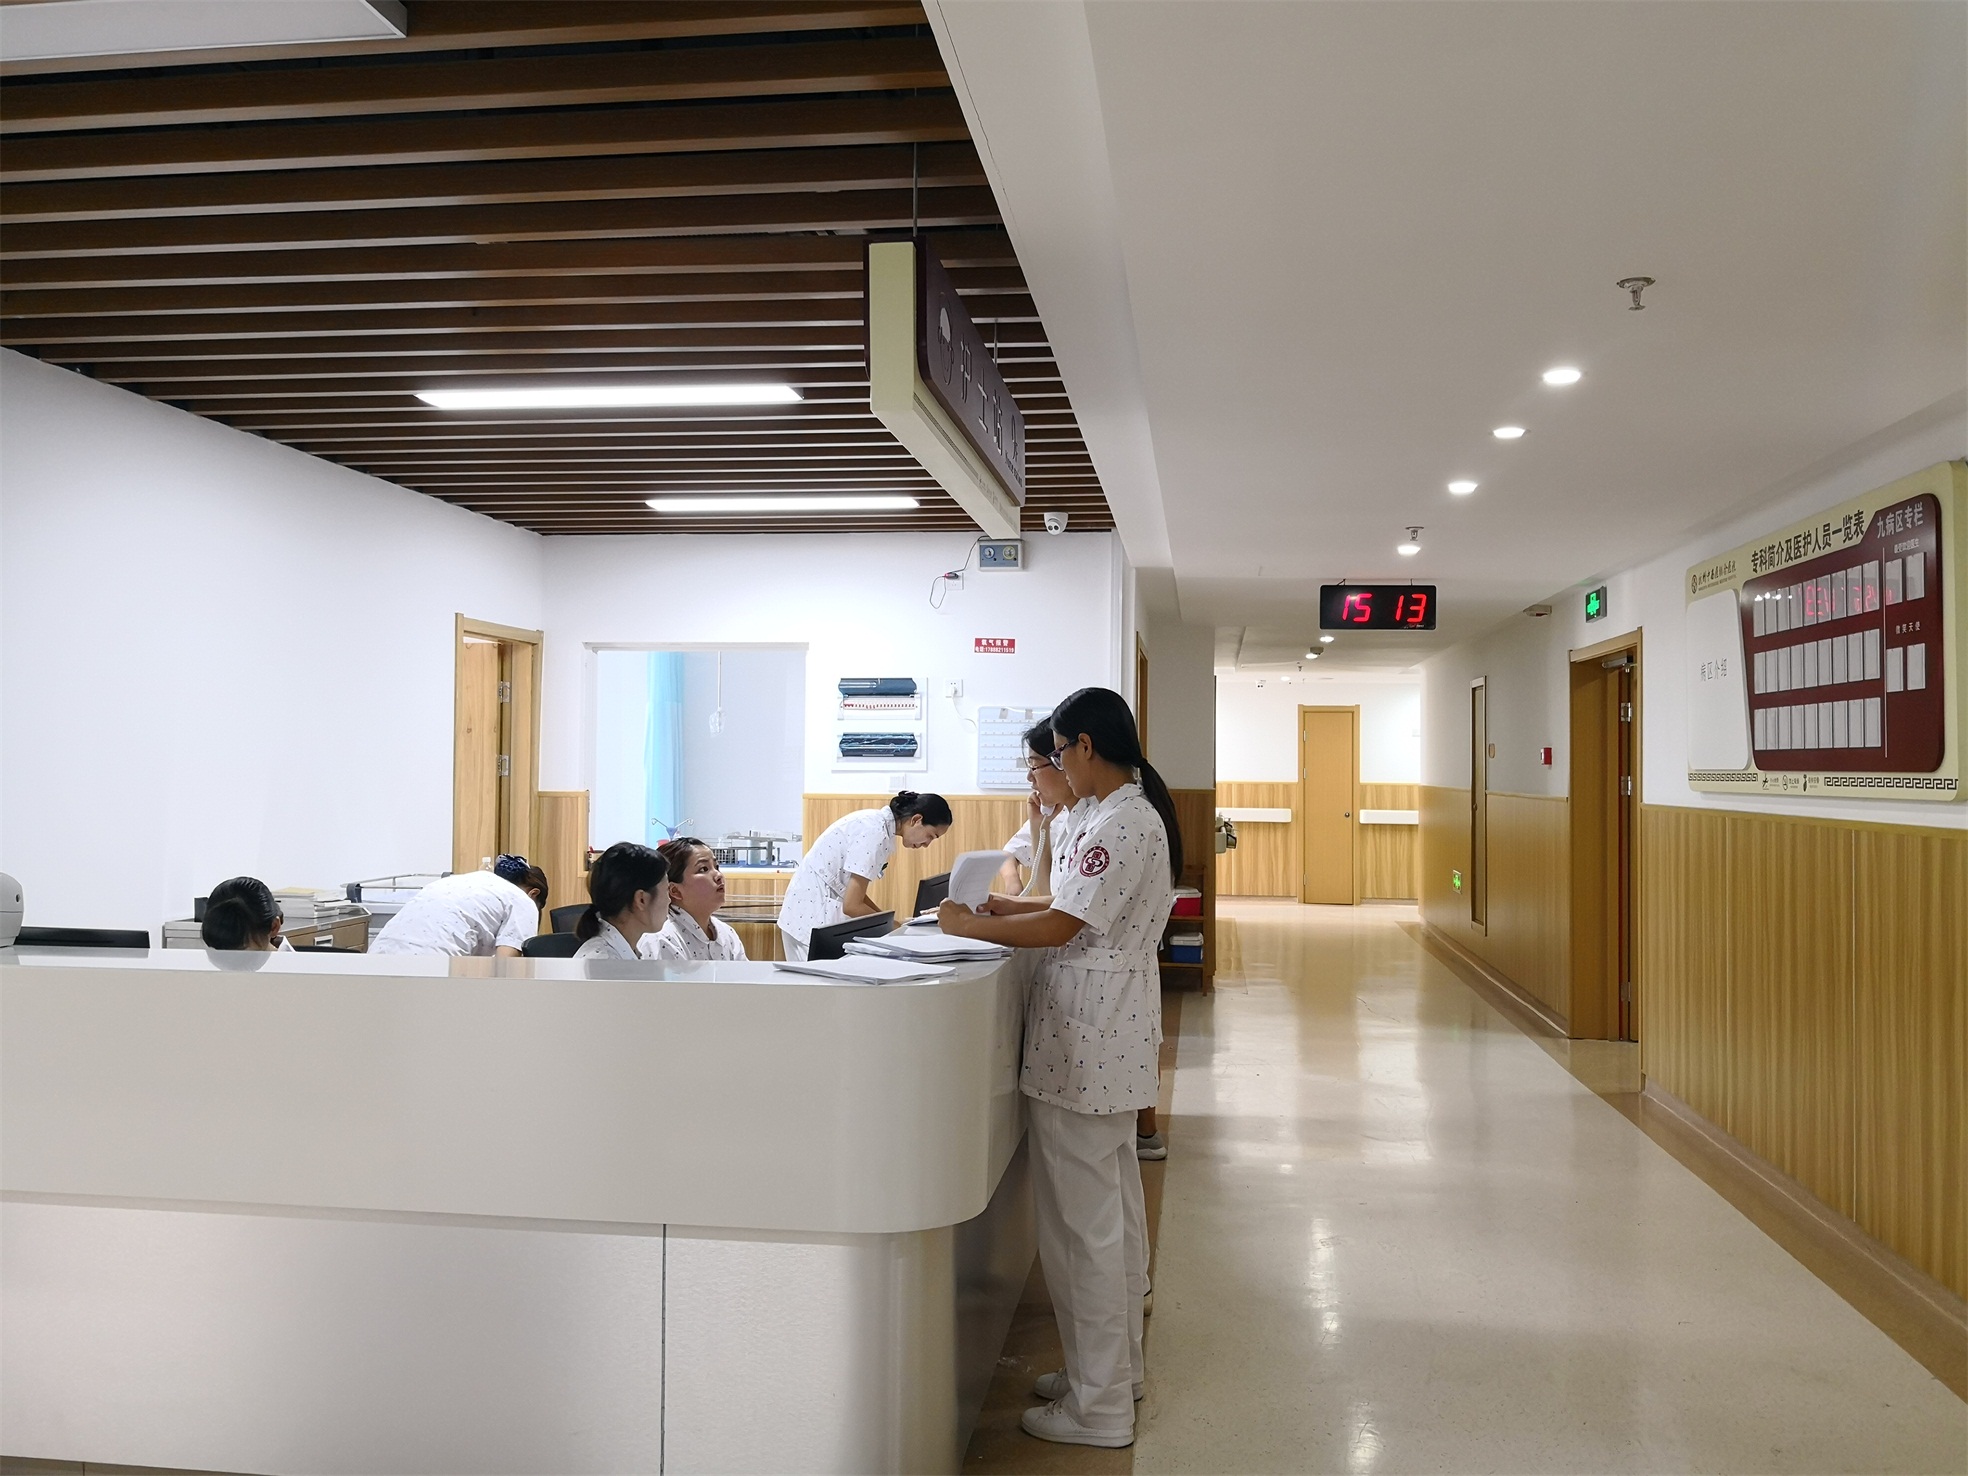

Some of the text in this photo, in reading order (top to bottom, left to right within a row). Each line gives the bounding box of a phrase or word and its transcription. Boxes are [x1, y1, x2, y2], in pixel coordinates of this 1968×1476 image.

[1877, 501, 1923, 539] 九病区专栏
[1751, 509, 1865, 574] 专科简介及医护人员一览表
[1342, 593, 1427, 623] 15 13
[1700, 658, 1727, 682] 病区介绍
